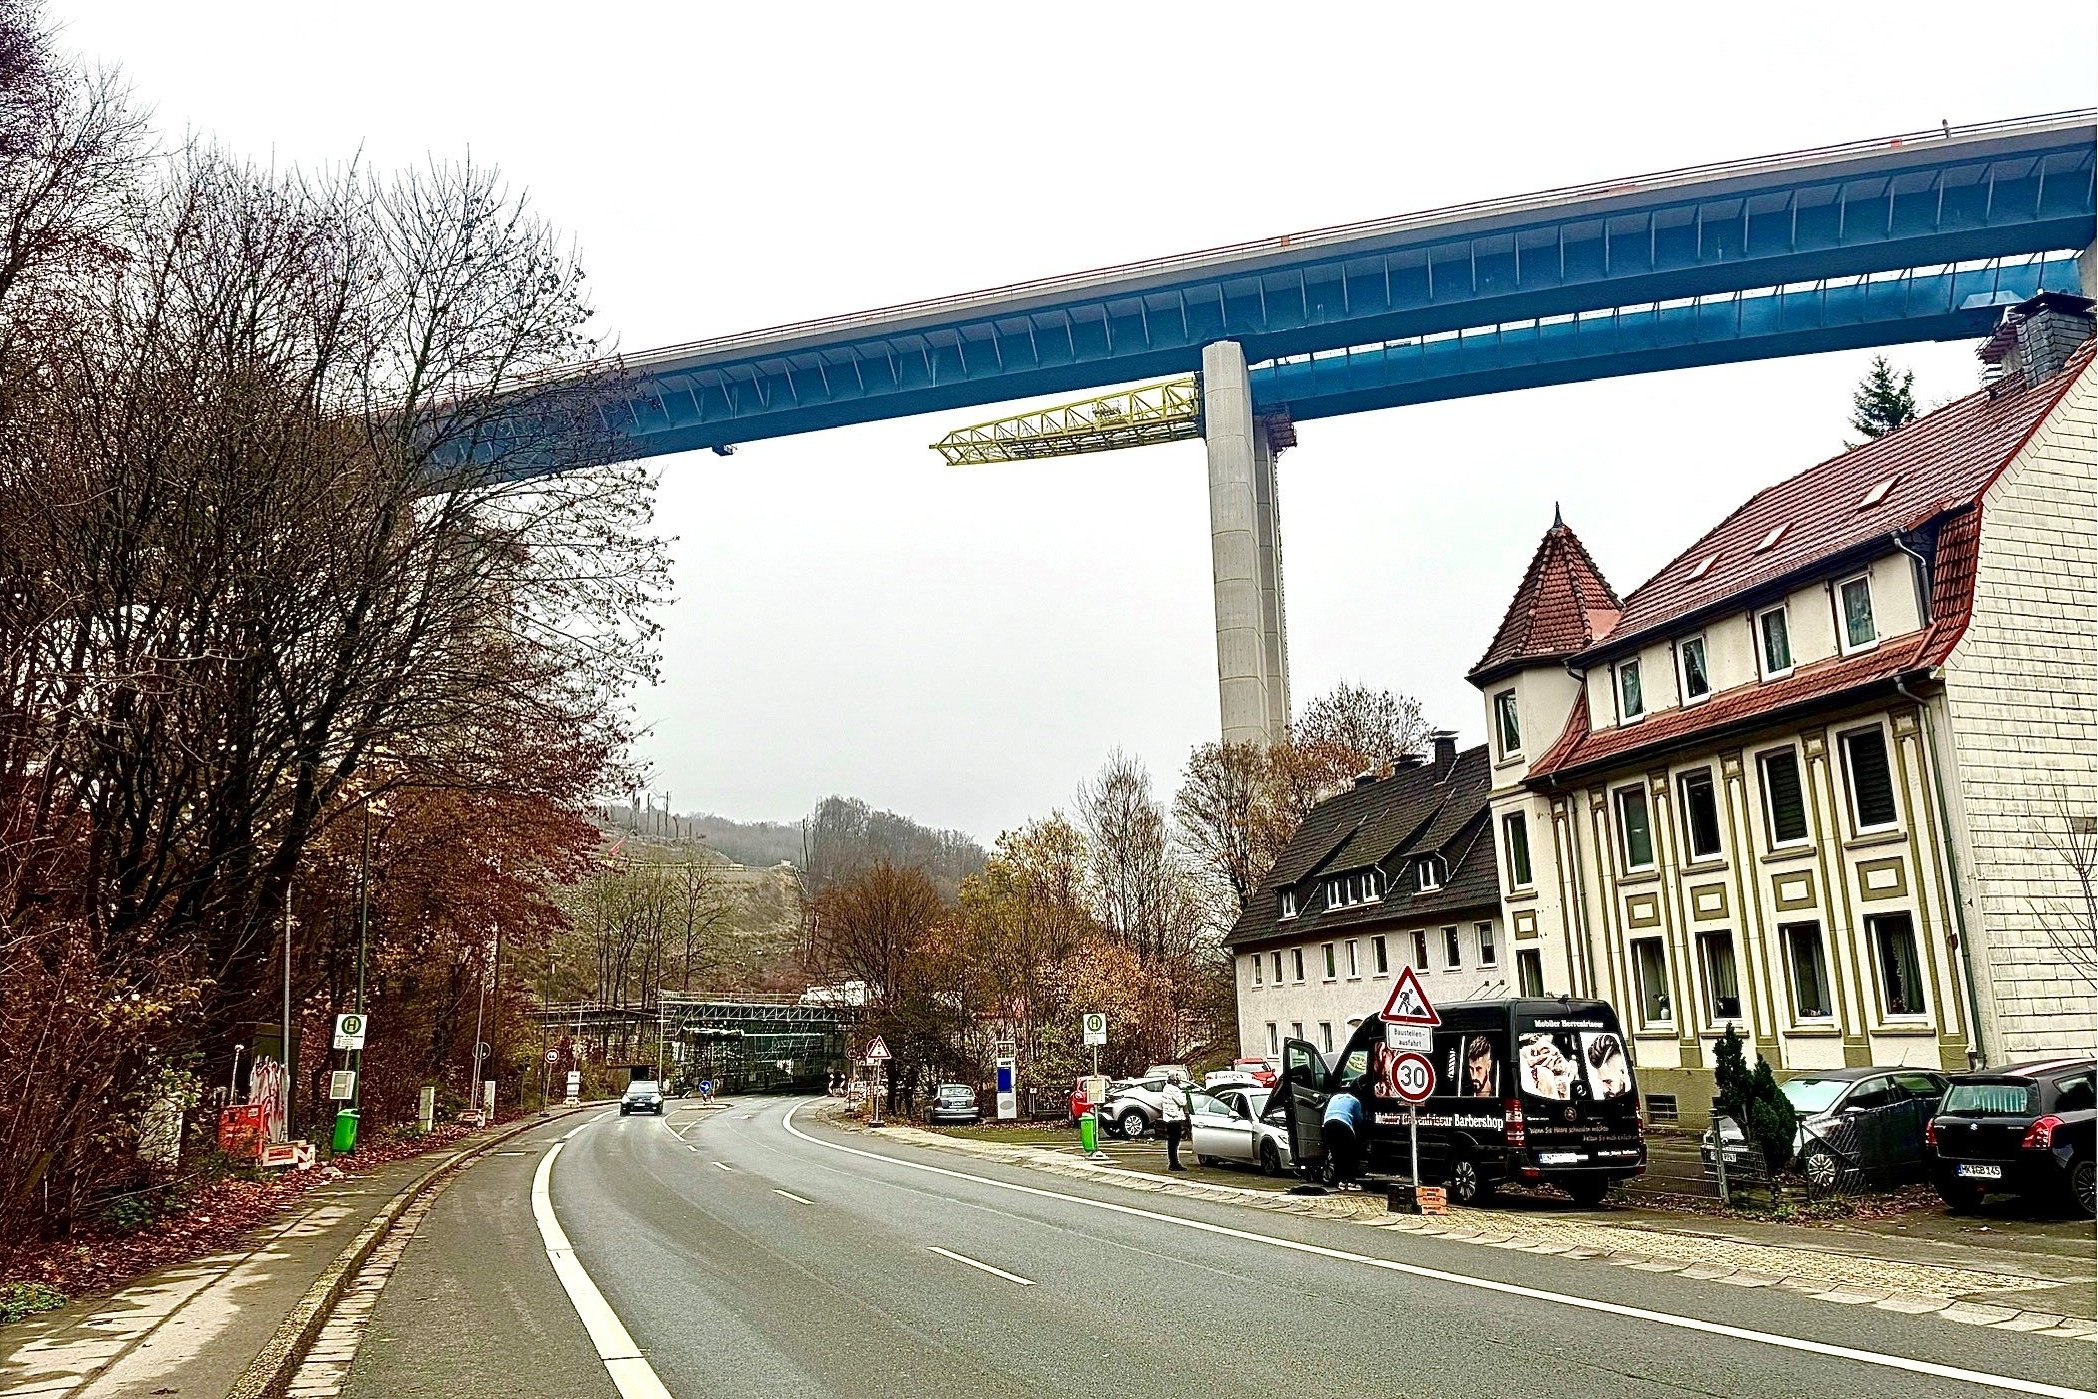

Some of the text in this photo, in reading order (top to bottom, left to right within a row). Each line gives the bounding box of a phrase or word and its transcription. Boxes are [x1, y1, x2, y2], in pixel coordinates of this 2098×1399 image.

[346, 1019, 357, 1031] H
[1091, 1018, 1098, 1028] H
[1394, 1027, 1426, 1038] Baustellen-
[1398, 1039, 1422, 1048] ausfahrt
[1400, 1064, 1425, 1089] 30
[1454, 1113, 1504, 1132] Barbershop
[1986, 1166, 2001, 1176] 145
